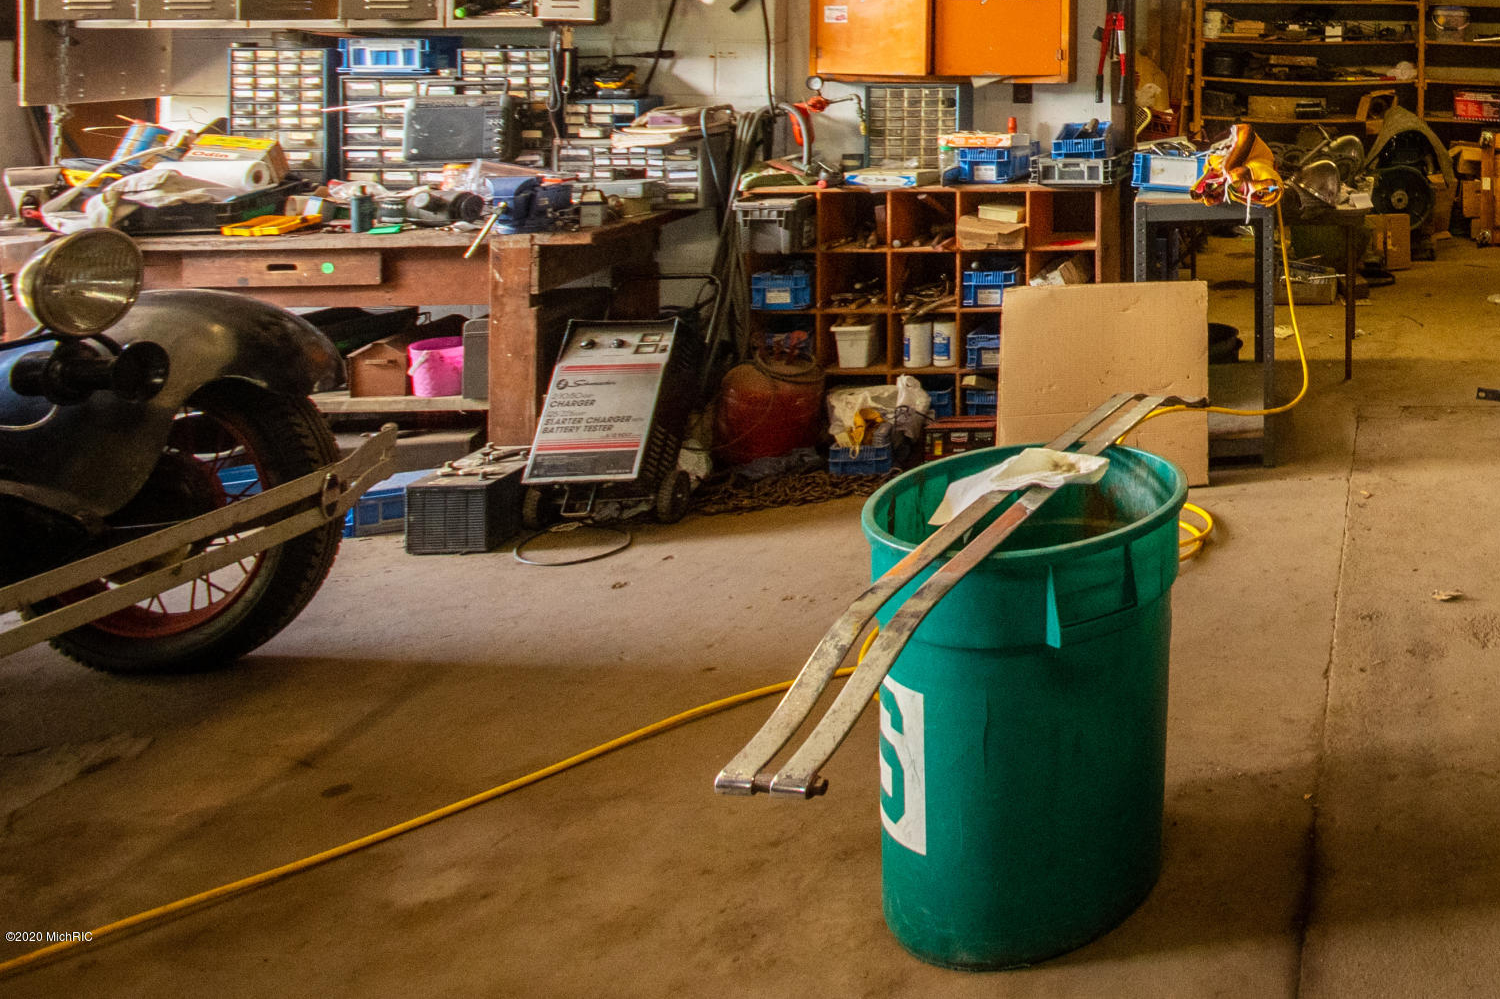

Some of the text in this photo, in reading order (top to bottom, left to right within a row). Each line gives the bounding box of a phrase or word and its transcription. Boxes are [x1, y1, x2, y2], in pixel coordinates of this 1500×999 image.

[550, 399, 597, 408] CHARGER
[544, 415, 632, 426] STARTER CHARGER
[542, 425, 615, 434] BATTERY TESTER
